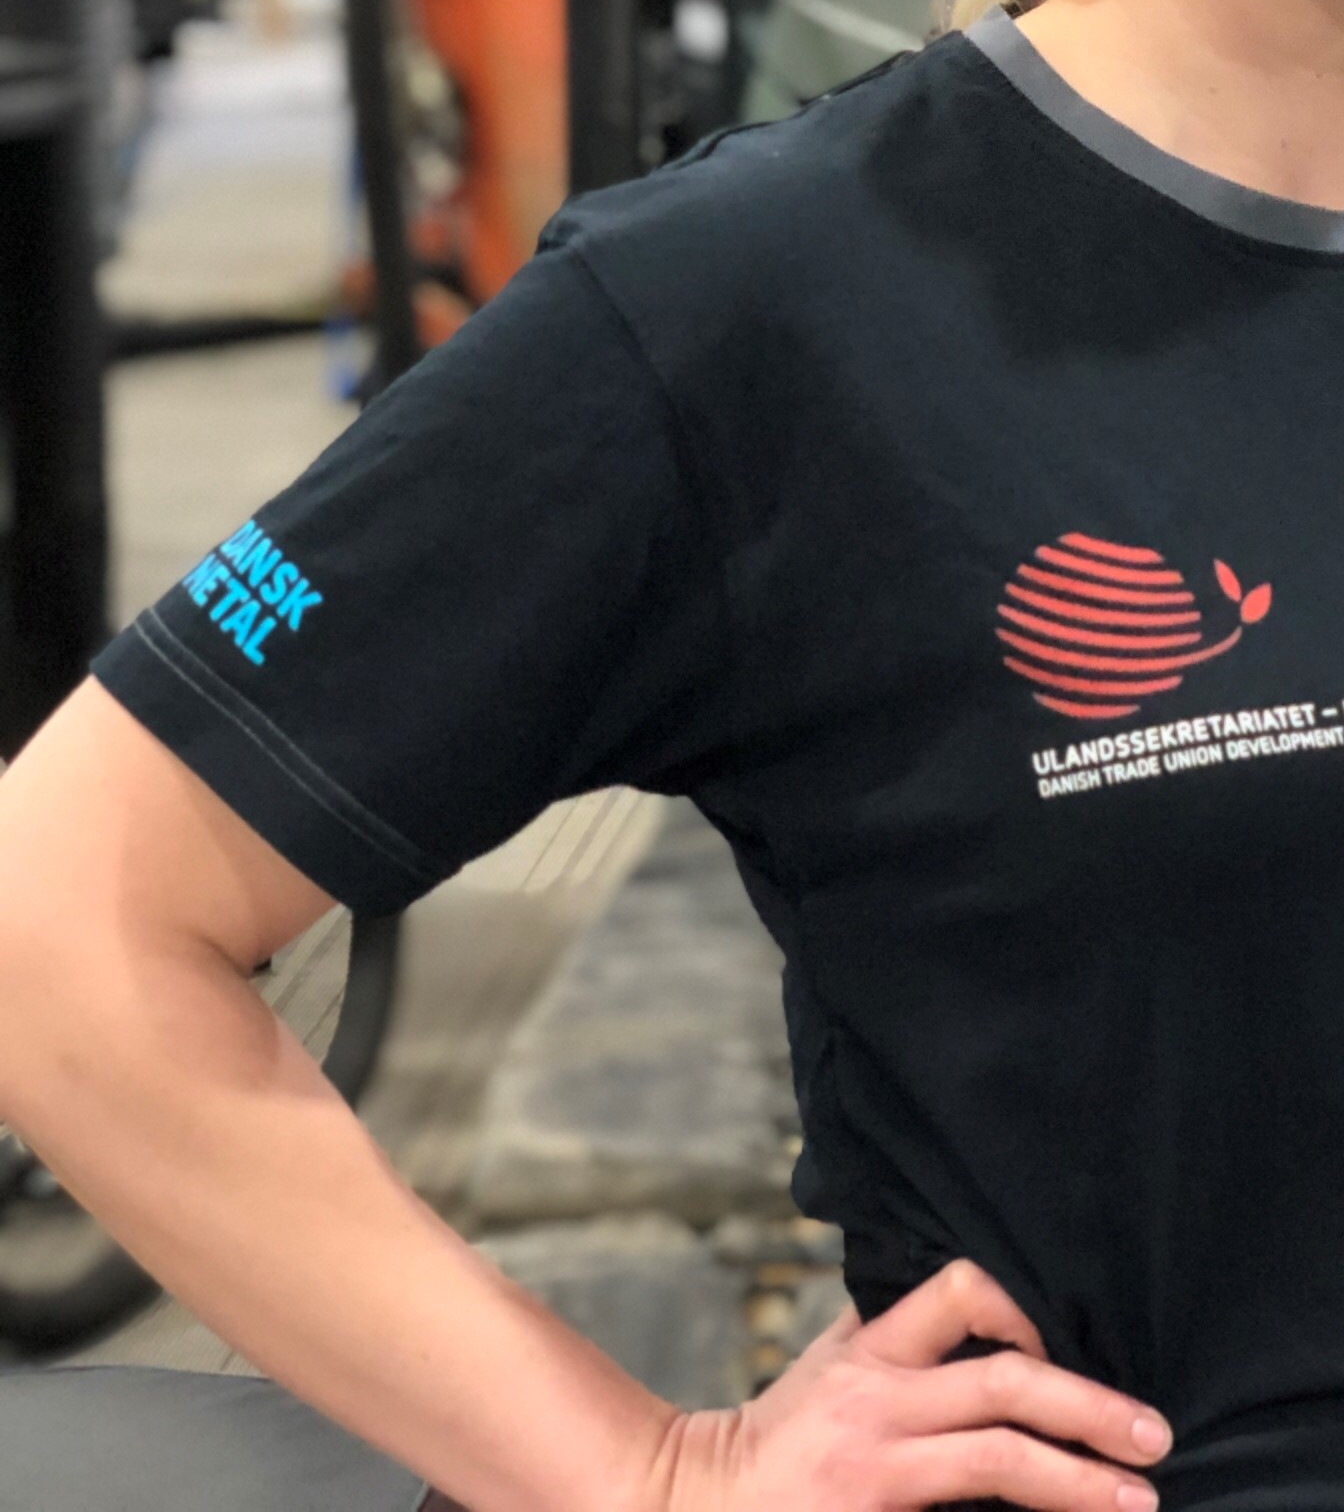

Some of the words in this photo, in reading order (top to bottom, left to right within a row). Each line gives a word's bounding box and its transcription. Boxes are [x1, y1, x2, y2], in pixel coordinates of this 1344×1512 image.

[1032, 701, 1316, 775] ULANDSSEKRETARIATET
[1037, 768, 1101, 800] DANISH
[1102, 755, 1161, 785] TRADE
[1163, 741, 1224, 774] UNION
